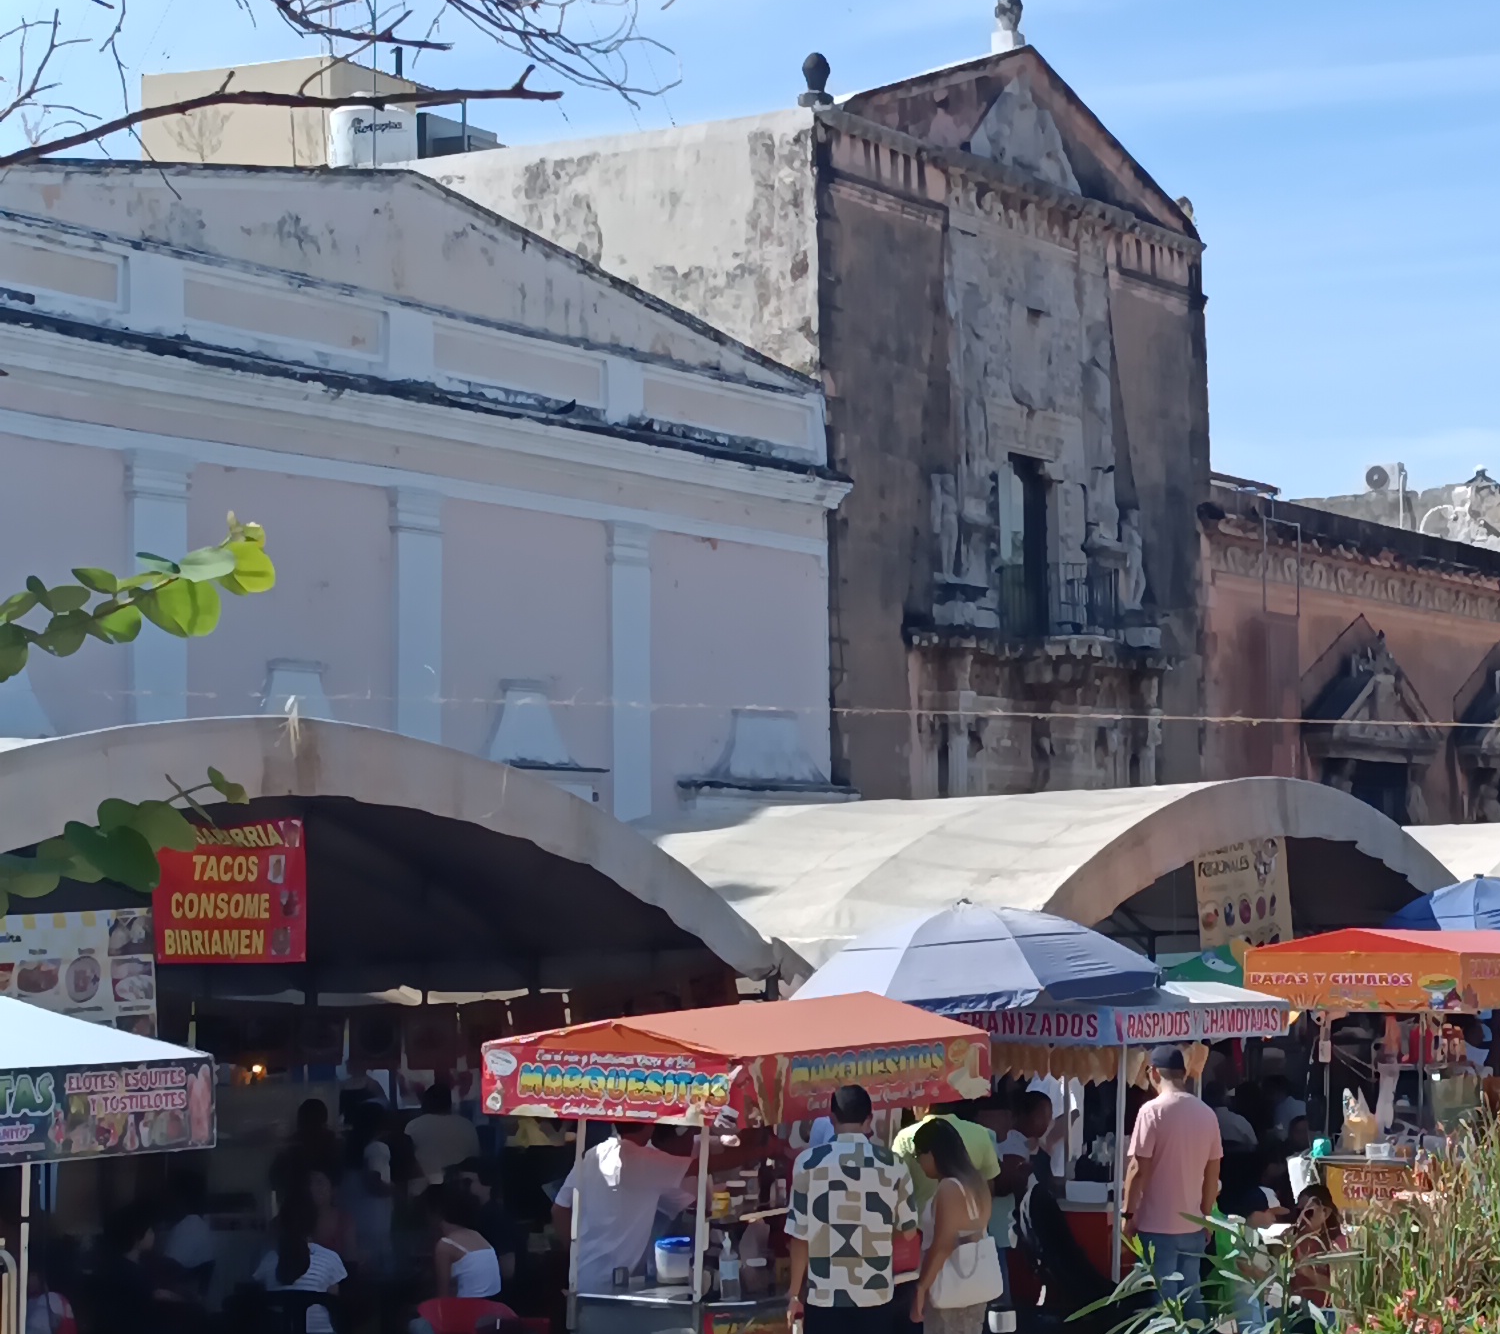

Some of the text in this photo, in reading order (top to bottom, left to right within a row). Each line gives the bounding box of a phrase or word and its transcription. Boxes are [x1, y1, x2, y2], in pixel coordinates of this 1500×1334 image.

[192, 854, 258, 882] TACOS
[171, 892, 270, 919] CONSOME
[164, 929, 264, 955] BIRRIAMEN
[1250, 972, 1413, 986] PAPAS Y CHURROS
[1126, 1011, 1190, 1039] RASPADOS
[1202, 1008, 1278, 1034] CHAMOYADAS
[123, 1068, 186, 1089] ESQUITES
[517, 1062, 730, 1106] MARQUESITAS
